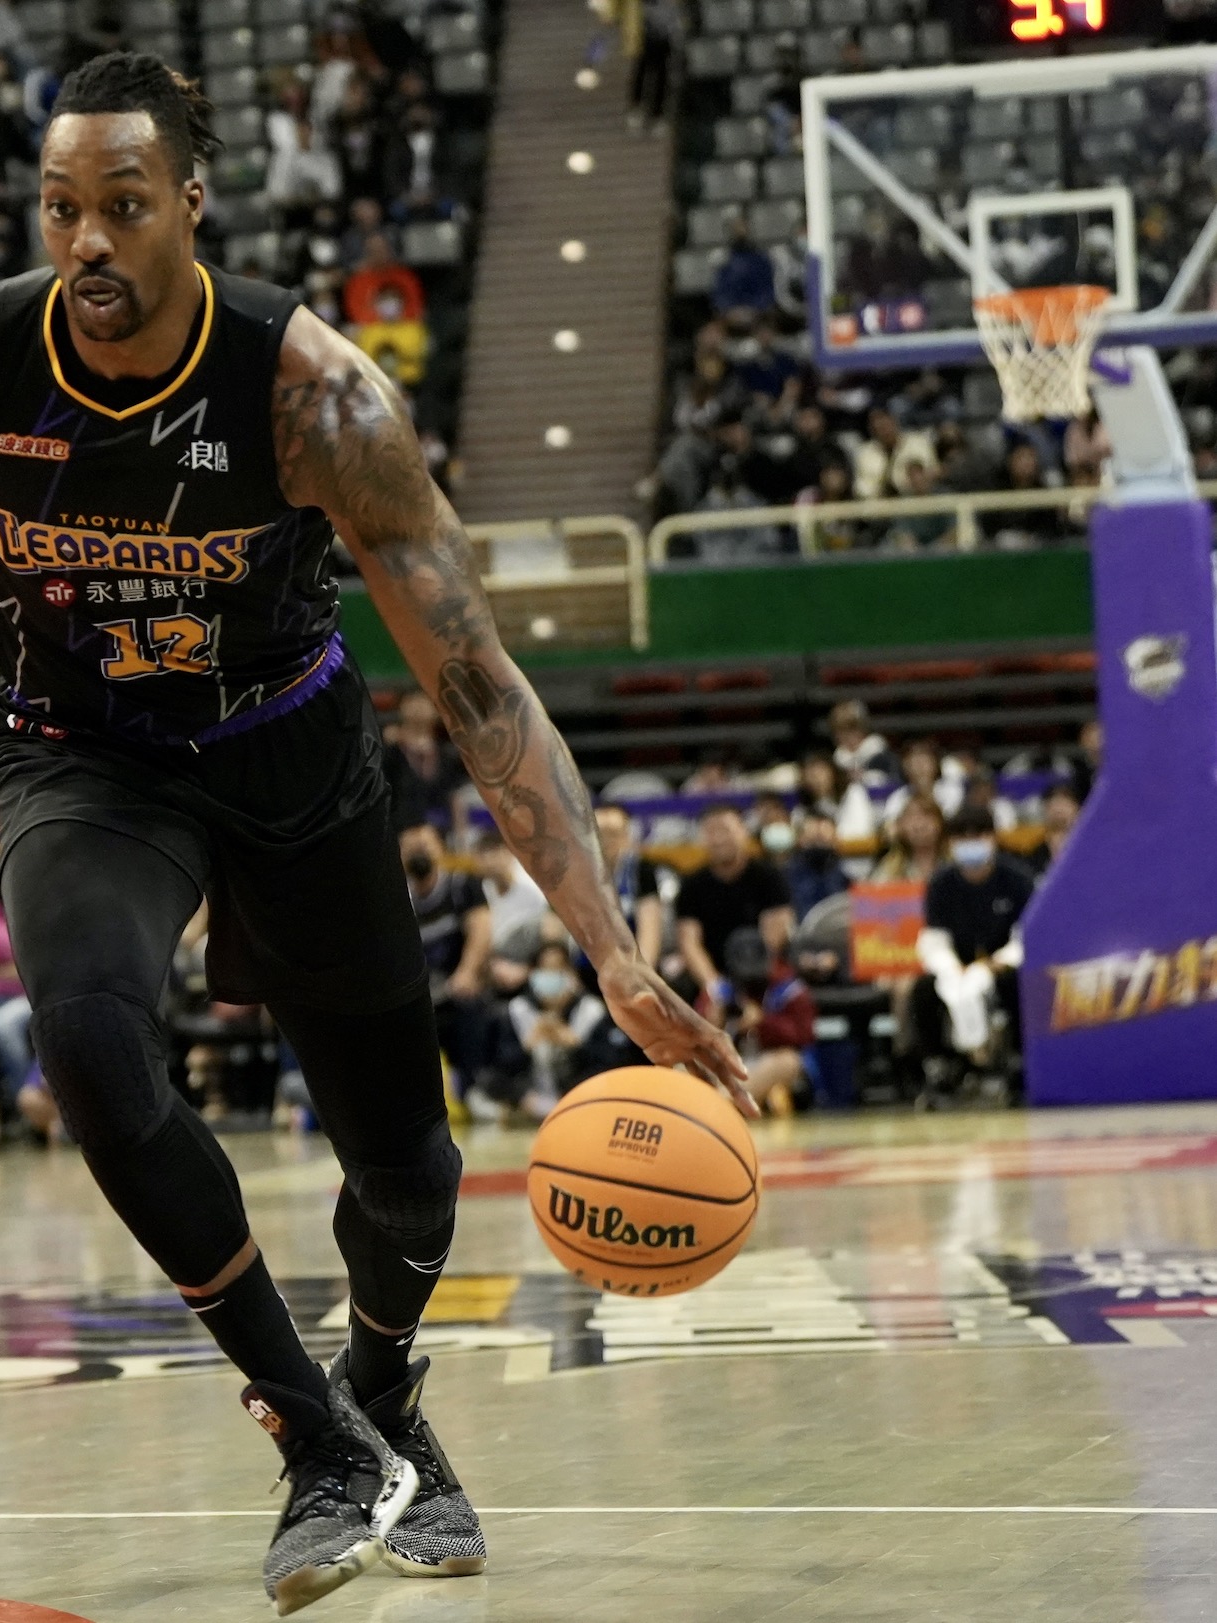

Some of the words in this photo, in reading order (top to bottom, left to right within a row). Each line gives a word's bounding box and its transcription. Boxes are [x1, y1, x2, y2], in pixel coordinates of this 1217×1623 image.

[59, 513, 171, 534] TAOYUAN
[86, 576, 208, 603] 永豐銀行
[92, 613, 214, 680] 12
[612, 1117, 663, 1145] FIBA
[549, 1183, 696, 1248] Wilson
